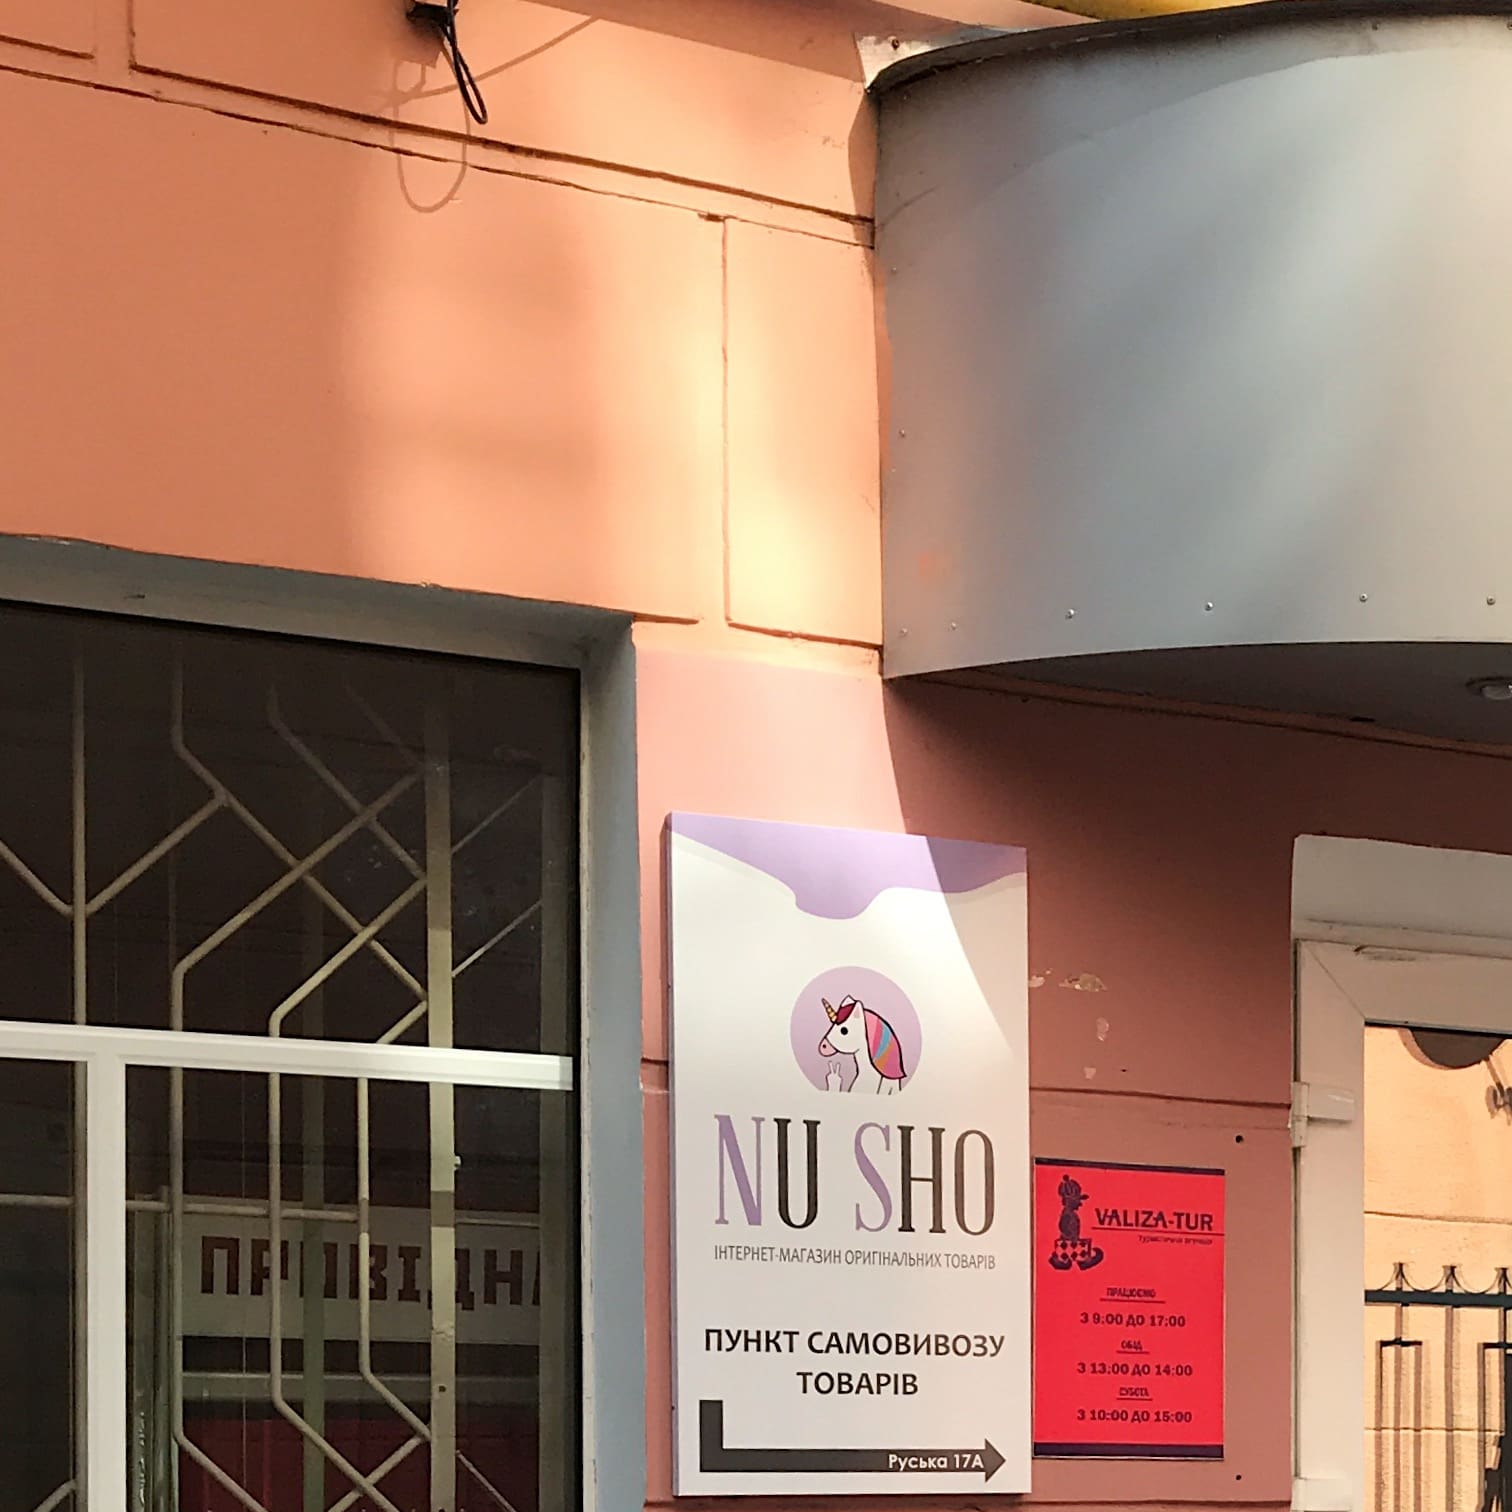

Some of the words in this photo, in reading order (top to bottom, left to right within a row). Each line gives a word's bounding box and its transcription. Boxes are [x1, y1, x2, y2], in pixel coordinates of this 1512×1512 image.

[714, 1114, 821, 1229] NU
[854, 1122, 996, 1235] SHO
[1094, 1207, 1214, 1232] VALIZA-TUR
[713, 1245, 842, 1265] ІНТЕРНЕТ-МАГАЗИН
[844, 1250, 942, 1268] ОРИГІНАЛЬНИХ
[945, 1254, 996, 1270] ТОВАРІВ
[1092, 1313, 1123, 1326] 9:00
[1125, 1315, 1145, 1328] ДО
[1149, 1315, 1186, 1328] 17:00
[704, 1328, 800, 1353] ПУНКТ
[807, 1331, 1005, 1358] САМОВИВОЗУ
[1090, 1362, 1129, 1375] 13:00
[1131, 1364, 1151, 1377] ДО
[1155, 1364, 1193, 1377] 14:00
[797, 1372, 919, 1396] ТОВАРІВ
[1090, 1409, 1129, 1422] 10:00
[1131, 1411, 1151, 1424] ДО
[1154, 1411, 1193, 1424] 15:00
[888, 1454, 948, 1471] Руська
